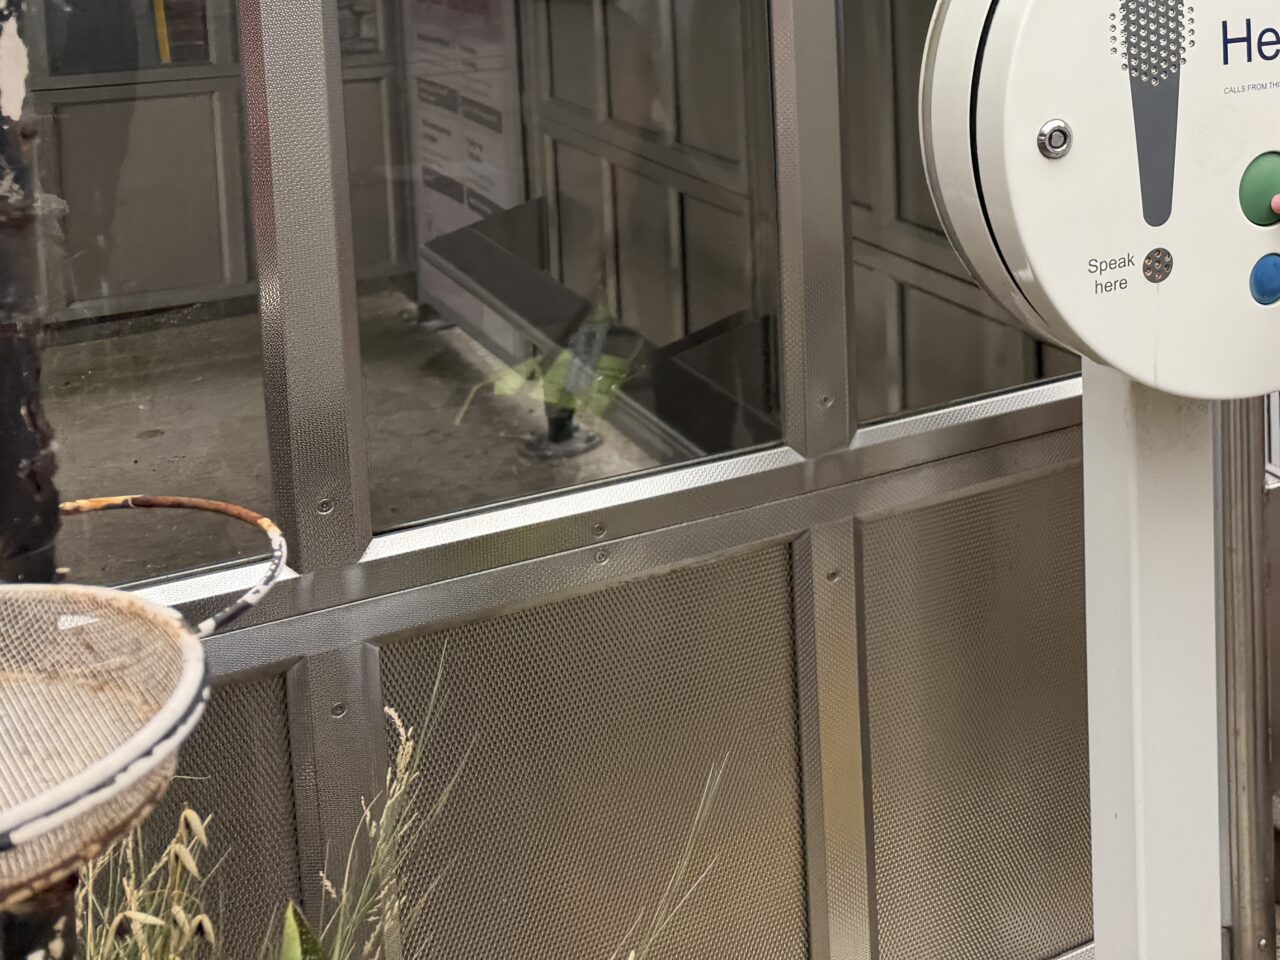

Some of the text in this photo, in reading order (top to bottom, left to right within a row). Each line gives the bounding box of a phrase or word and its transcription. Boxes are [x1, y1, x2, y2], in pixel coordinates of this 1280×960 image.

[1224, 86, 1246, 95] CALLS
[1247, 83, 1268, 92] FROM
[1088, 252, 1135, 276] Speak
[1095, 278, 1128, 294] here
